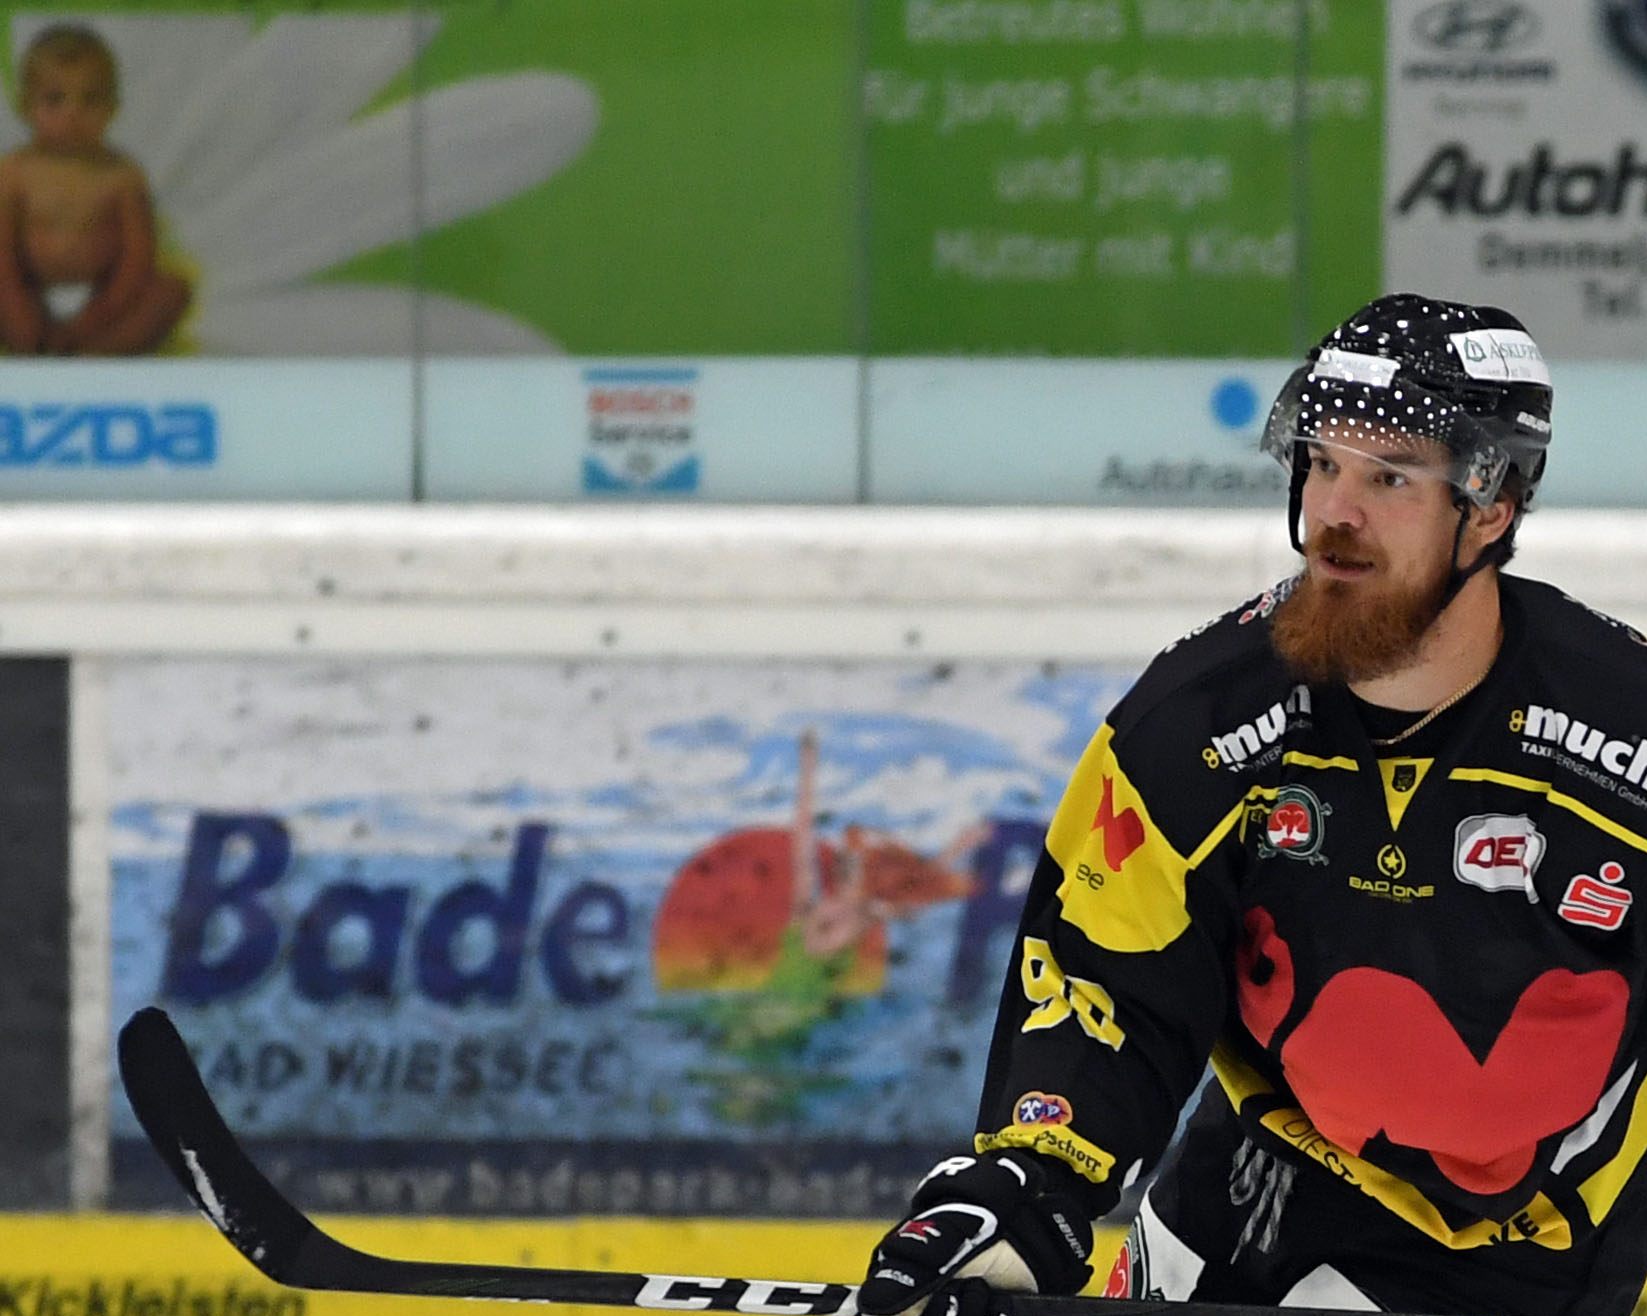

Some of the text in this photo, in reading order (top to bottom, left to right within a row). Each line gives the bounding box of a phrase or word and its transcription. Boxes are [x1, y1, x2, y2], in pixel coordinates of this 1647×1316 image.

[156, 811, 632, 1004] Bade
[1348, 875, 1390, 893] BAD
[1392, 884, 1435, 898] ONE
[1033, 1129, 1103, 1174] Pschorr
[1052, 1211, 1086, 1260] BAUER
